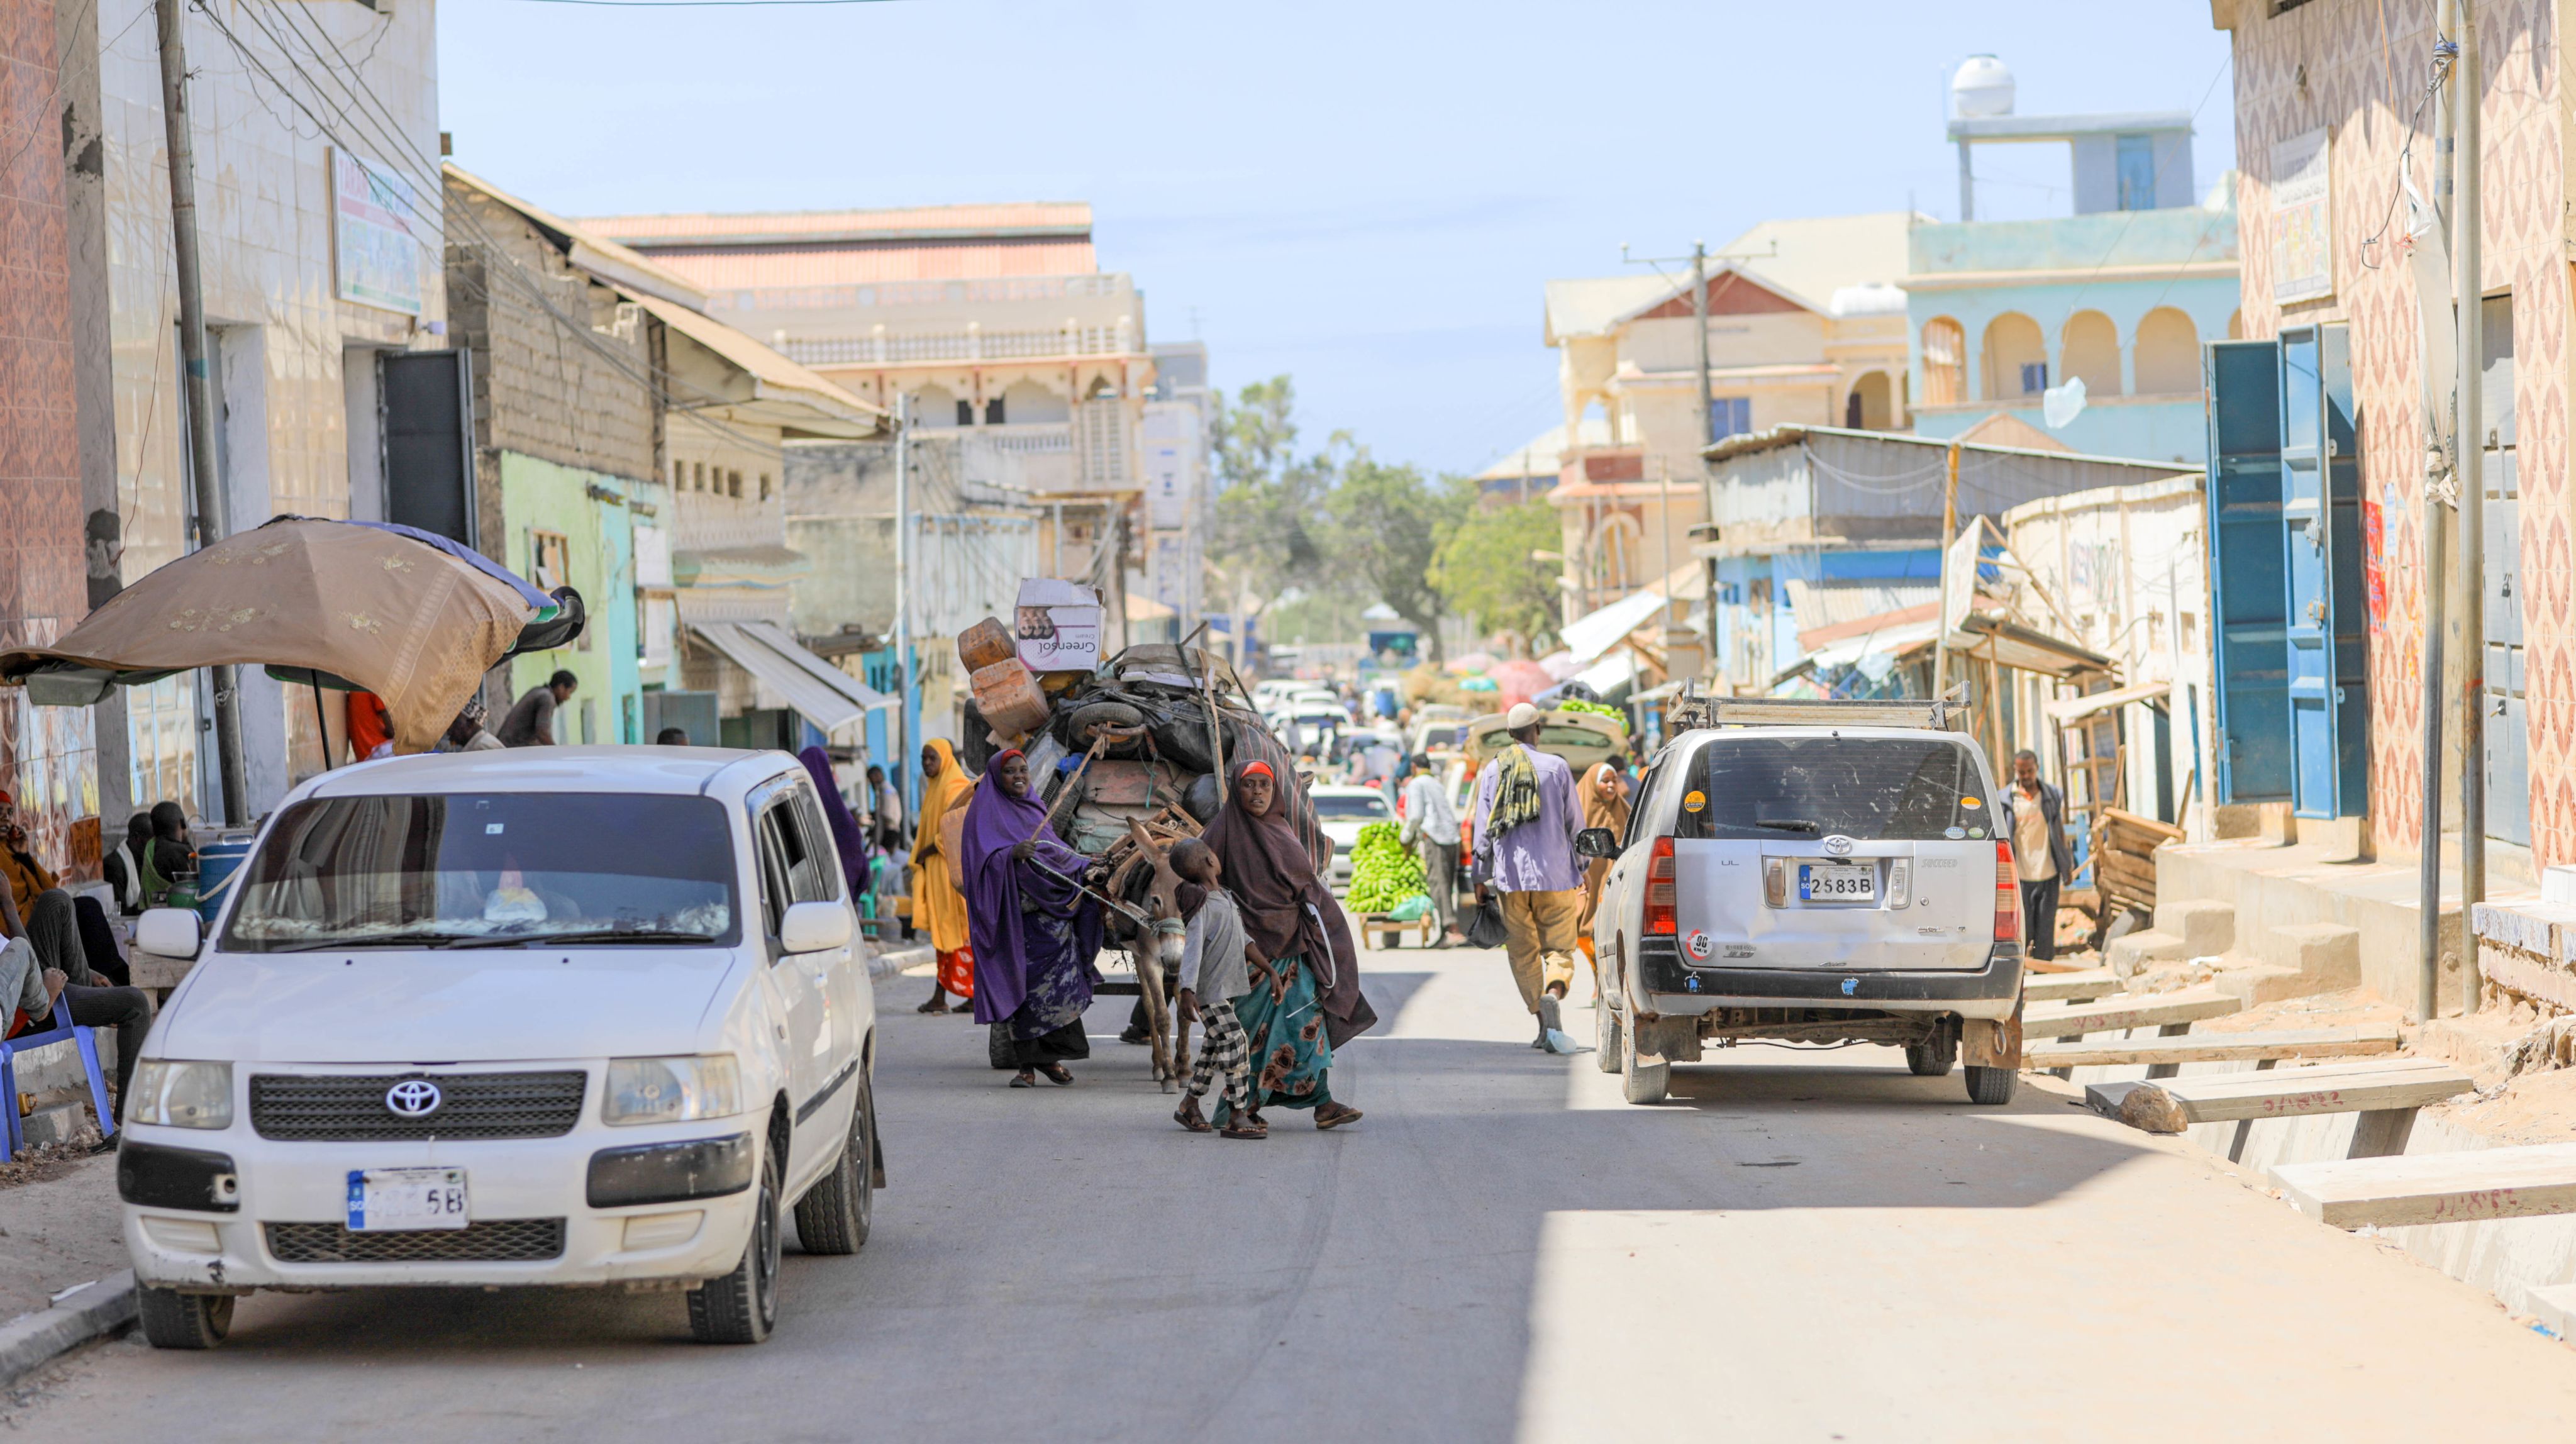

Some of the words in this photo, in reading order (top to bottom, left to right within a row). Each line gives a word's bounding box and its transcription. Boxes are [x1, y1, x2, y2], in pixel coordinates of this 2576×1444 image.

[1039, 641, 1096, 653] Greensol
[1812, 879, 1871, 894] 2583B
[349, 1201, 364, 1211] SO
